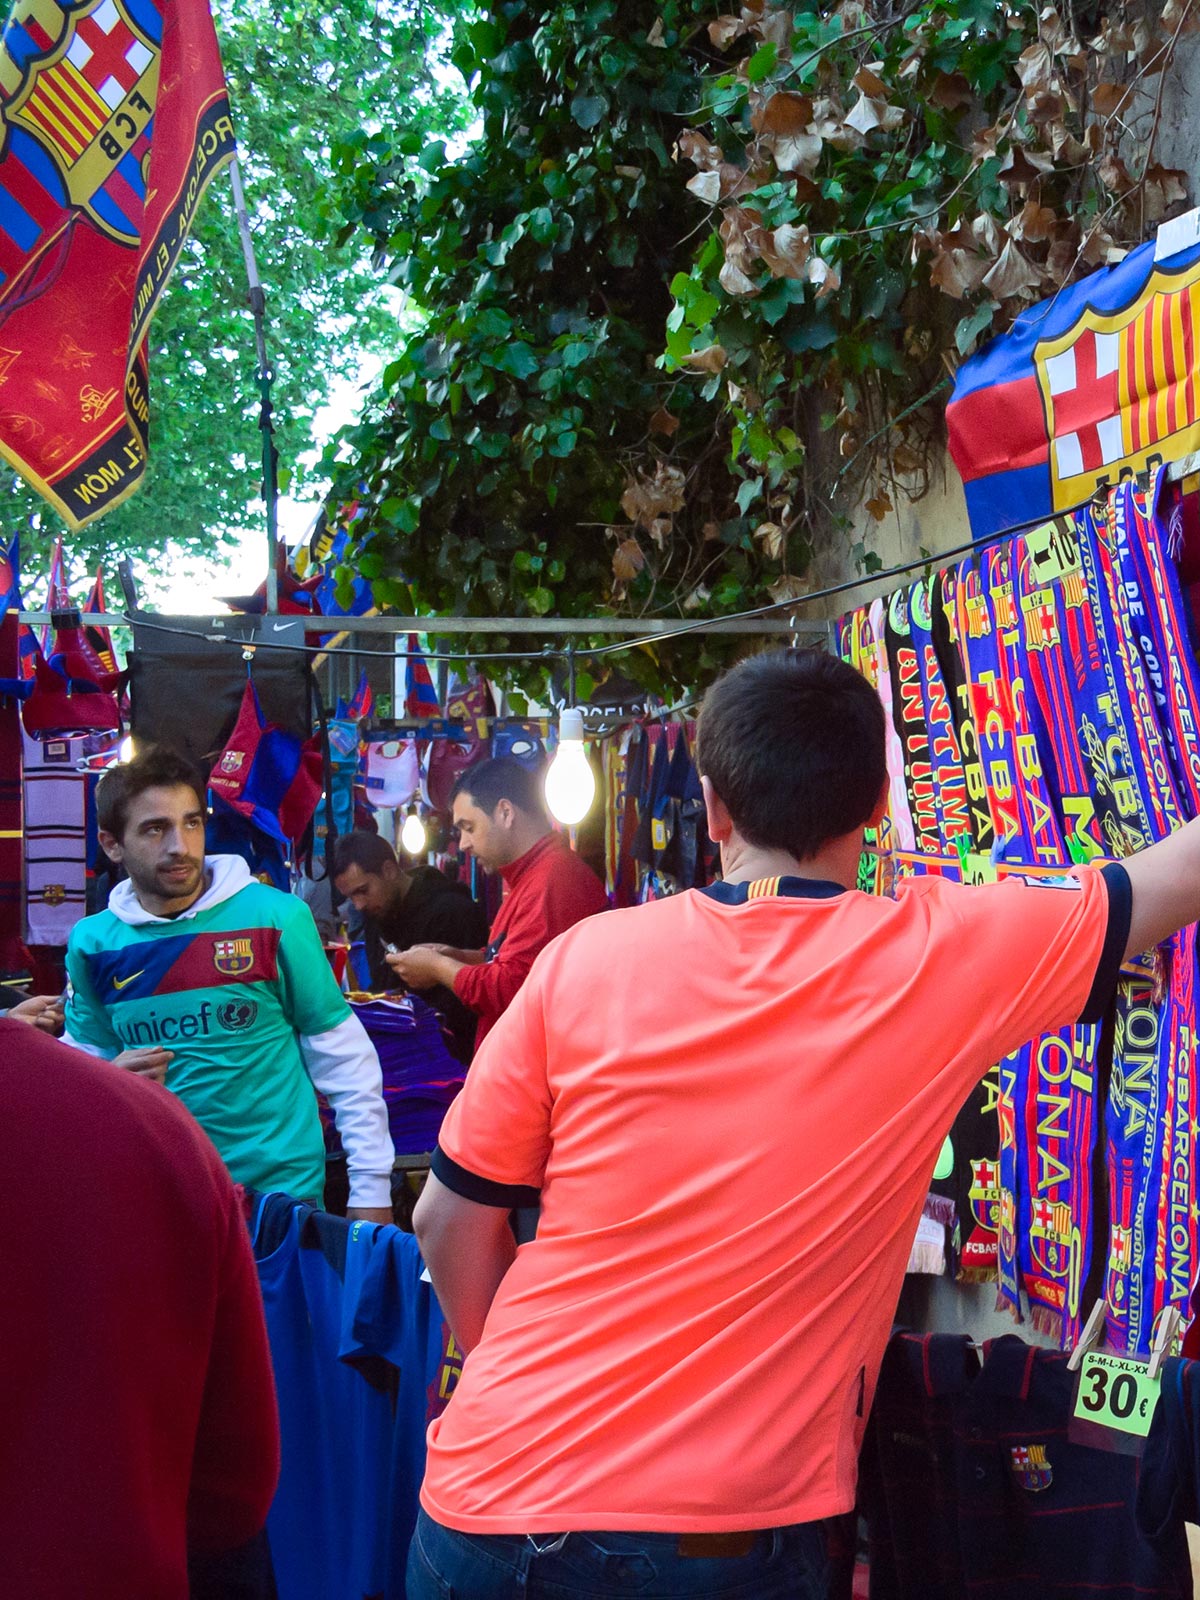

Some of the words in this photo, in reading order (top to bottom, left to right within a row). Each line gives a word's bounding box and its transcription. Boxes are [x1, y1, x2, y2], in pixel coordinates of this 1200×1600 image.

[1076, 521, 1104, 640] 24/04/2012
[1103, 662, 1120, 719] CAMP
[1114, 483, 1130, 562] FINAL
[1125, 581, 1144, 617] DE
[1139, 634, 1168, 708] COPA
[118, 1001, 213, 1045] unicef
[1132, 1189, 1150, 1267] LONDON
[1170, 1025, 1190, 1300] FCBARCELONA
